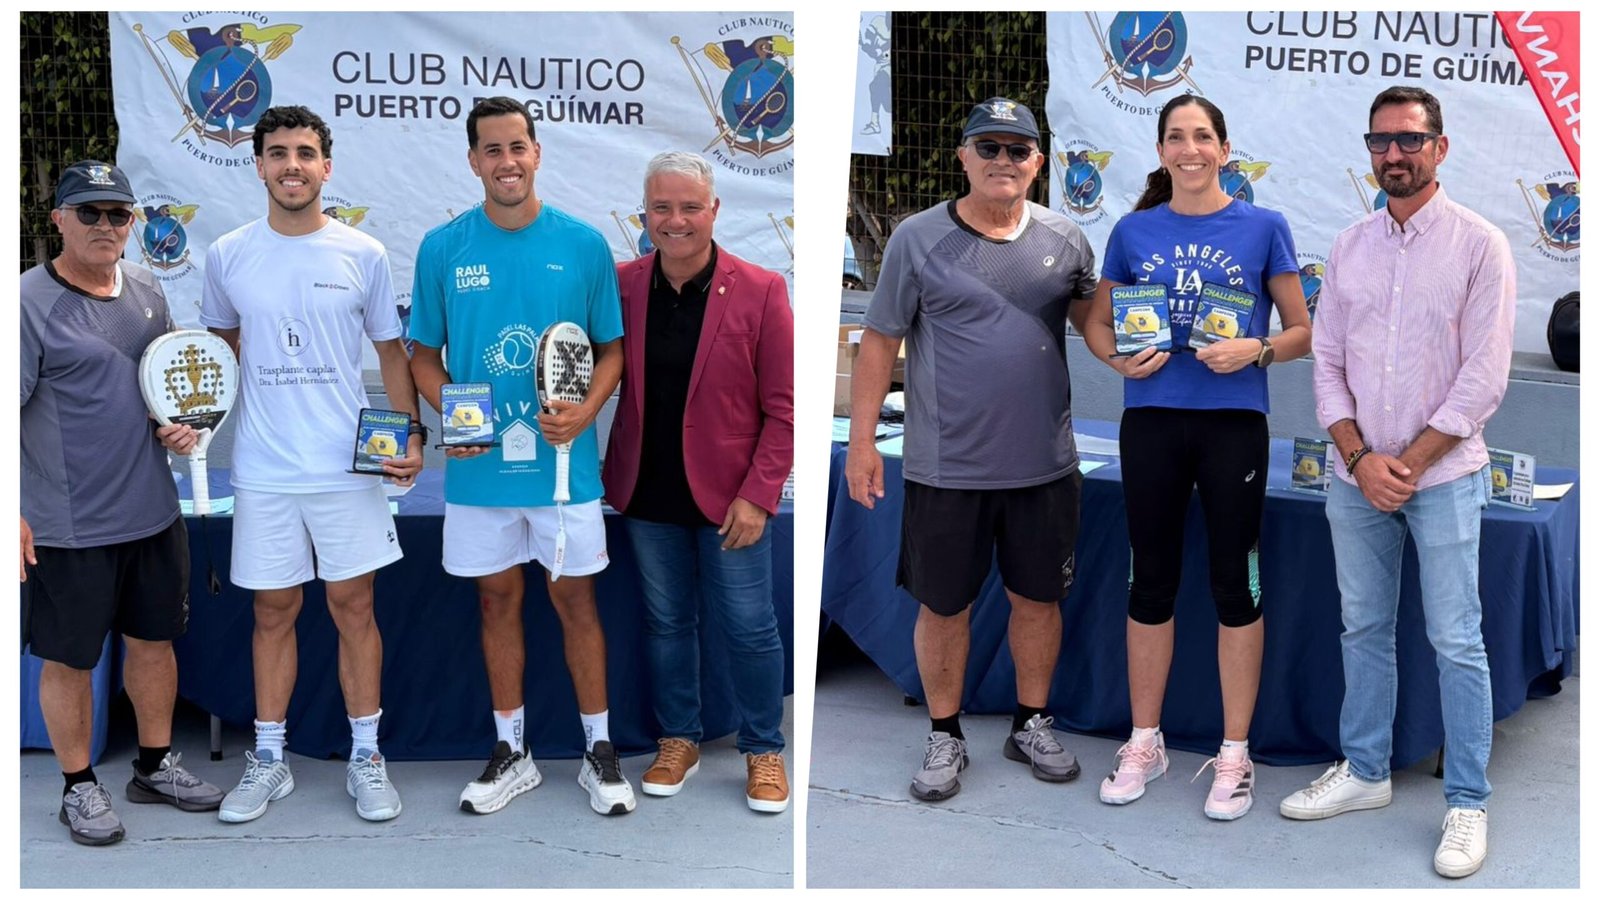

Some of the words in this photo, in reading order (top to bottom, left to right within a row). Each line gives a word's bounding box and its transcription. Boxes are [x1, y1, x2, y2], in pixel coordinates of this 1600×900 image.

[718, 18, 747, 36] CLUB
[1247, 11, 1357, 39] CLUB
[1373, 11, 1515, 48] NAUTI
[332, 51, 446, 85] CLUB
[462, 55, 645, 91] NAUTICO
[1245, 45, 1370, 74] PUERTO
[1380, 52, 1423, 79] DE
[1432, 52, 1528, 86] GÜÍMA
[334, 94, 461, 119] PUERTO
[1101, 85, 1137, 114] PUERTO
[1139, 107, 1153, 116] DE
[181, 138, 223, 166] PUERTO
[225, 158, 240, 167] DE
[1231, 149, 1254, 161] AUTICO
[712, 149, 750, 175] PUERTO
[752, 167, 767, 176] DE
[455, 263, 491, 278] RAUL
[1139, 253, 1166, 282] LOS
[1174, 243, 1244, 286] ANGELES
[456, 275, 490, 289] LUGO
[1113, 289, 1165, 299] CHALLENGER
[1203, 287, 1255, 306] CHALLENGER
[256, 364, 304, 377] Trasplante
[275, 377, 298, 386] Isabel
[442, 387, 490, 395] CHALLENGER
[362, 414, 408, 424] CHALLENGER
